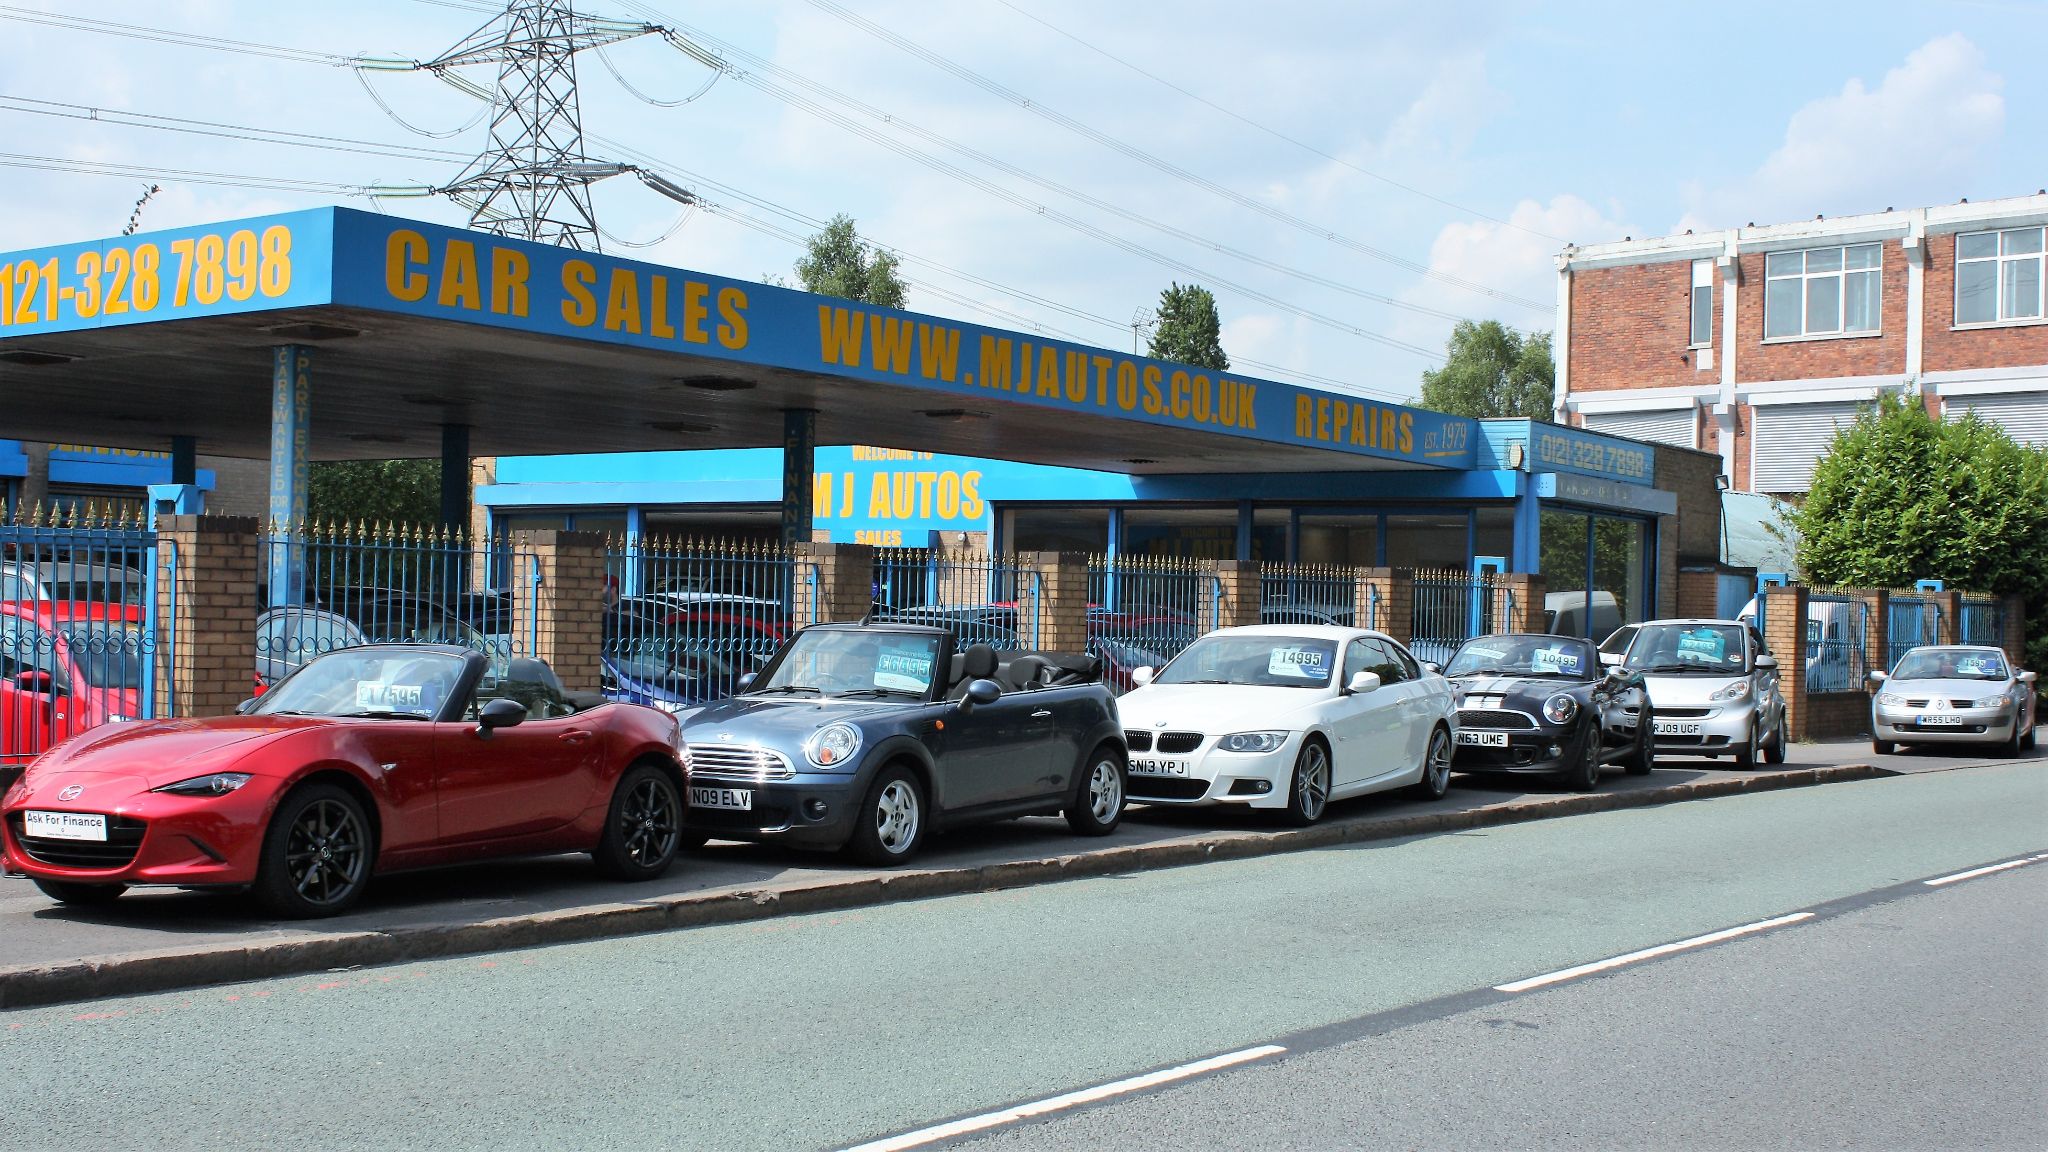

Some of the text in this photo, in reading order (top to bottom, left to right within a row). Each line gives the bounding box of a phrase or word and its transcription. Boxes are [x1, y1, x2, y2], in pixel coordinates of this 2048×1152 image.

[171, 225, 292, 306] 7898
[386, 229, 749, 350] CAR SALES
[818, 305, 1256, 430] WWW.MJAUTOS.CO.UK
[1296, 393, 1414, 454] REPAIRS
[1442, 421, 1467, 449] 1979
[1574, 440, 1604, 472] 328
[1607, 447, 1645, 478] 7898
[839, 472, 854, 518] J
[868, 471, 985, 520] AUTOS
[854, 529, 903, 547] SALES
[1481, 734, 1503, 745] UME
[1653, 723, 1700, 734] RJ09 UGF
[1128, 759, 1185, 774] SN13 YPJ
[692, 789, 749, 807] N09 ELV
[27, 812, 103, 827] Ask For Finance
